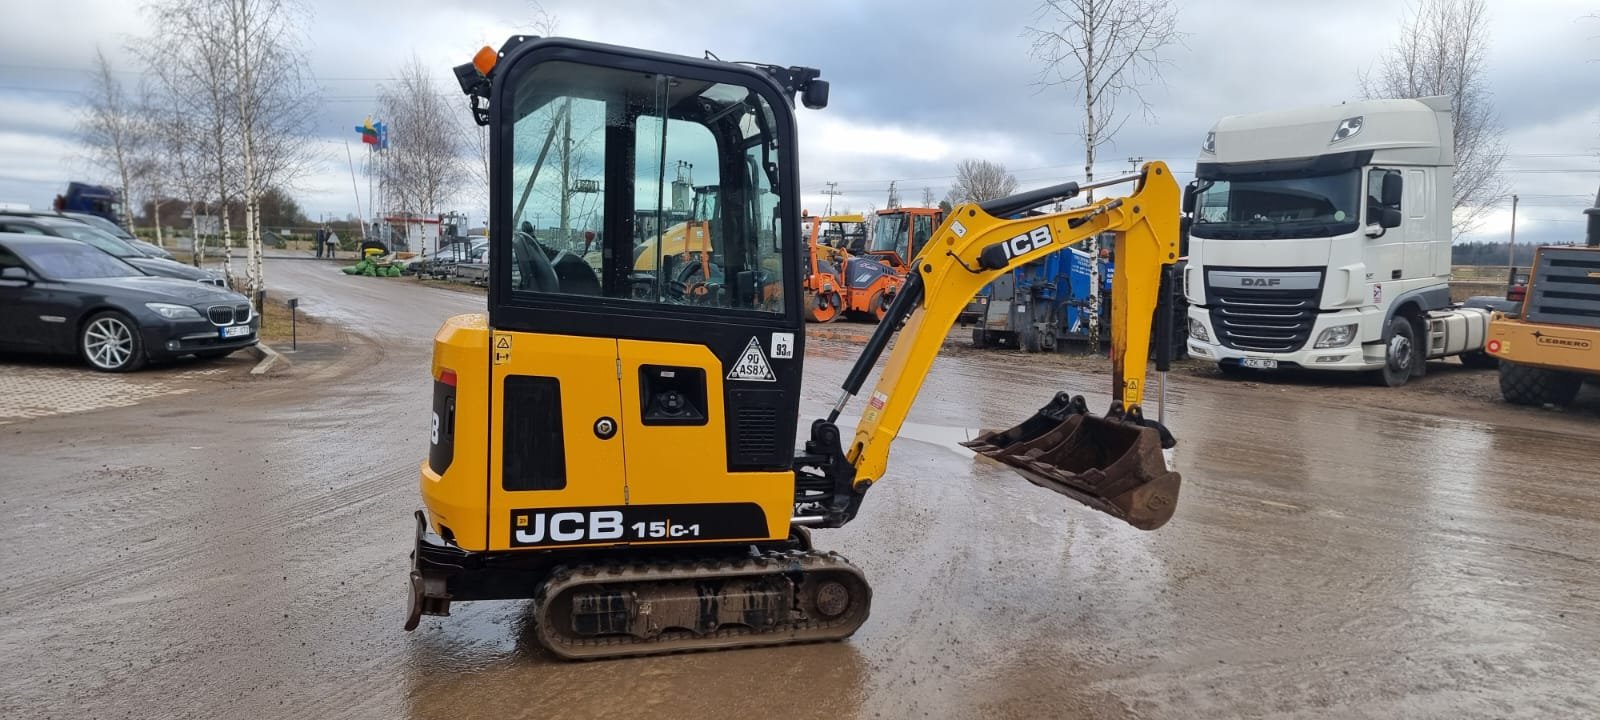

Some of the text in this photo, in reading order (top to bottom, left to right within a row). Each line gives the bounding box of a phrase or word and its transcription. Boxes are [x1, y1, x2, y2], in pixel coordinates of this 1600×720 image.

[1241, 278, 1280, 287] DAF
[1539, 337, 1589, 348] LEBRERO
[776, 343, 787, 356] 93
[516, 510, 624, 543] JCB
